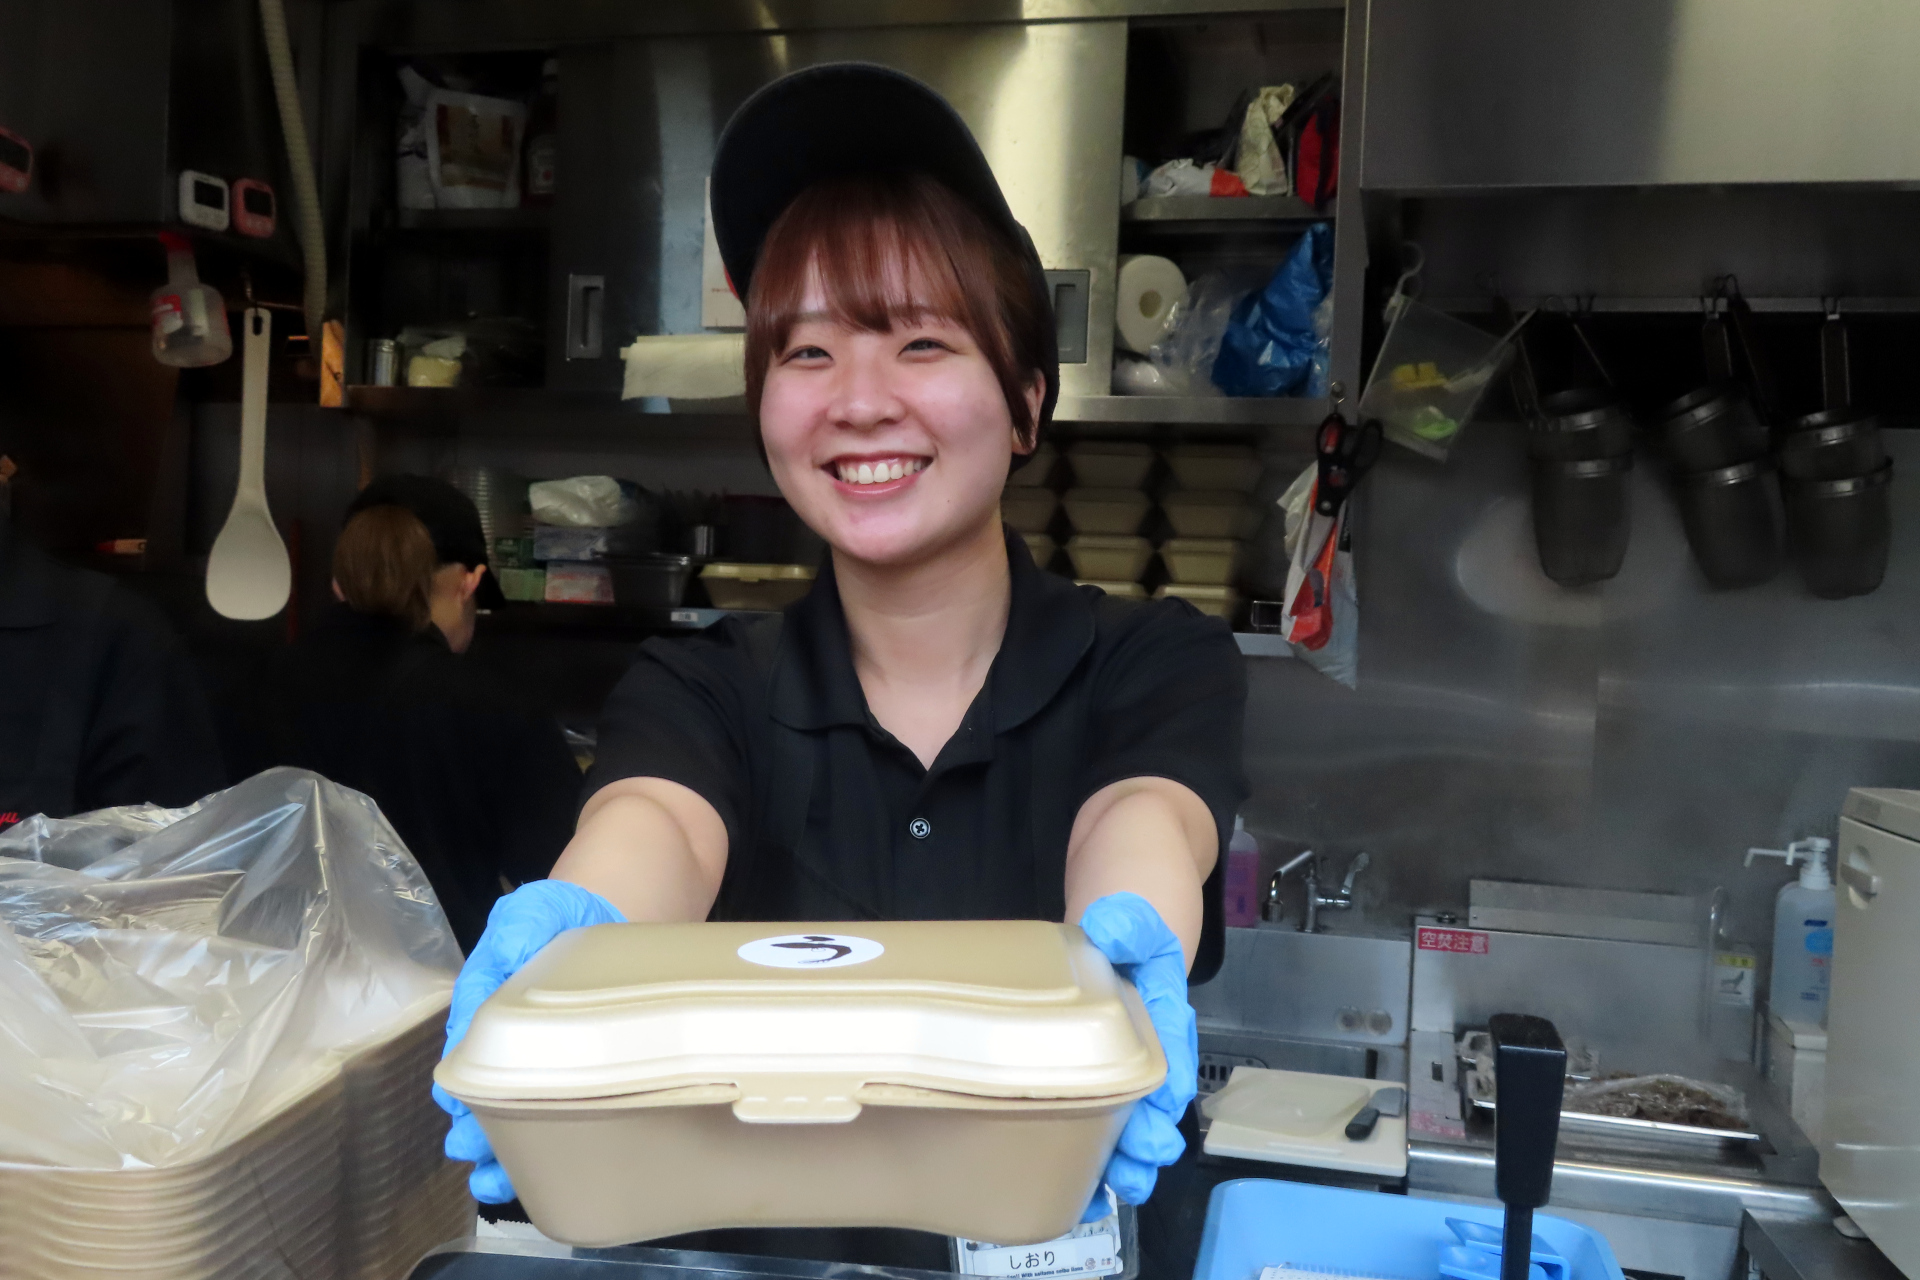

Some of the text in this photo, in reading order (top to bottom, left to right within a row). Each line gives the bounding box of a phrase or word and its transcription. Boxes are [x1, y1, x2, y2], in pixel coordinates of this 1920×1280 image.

[1421, 931, 1486, 953] 空焚注意
[1010, 1251, 1055, 1270] しおり
